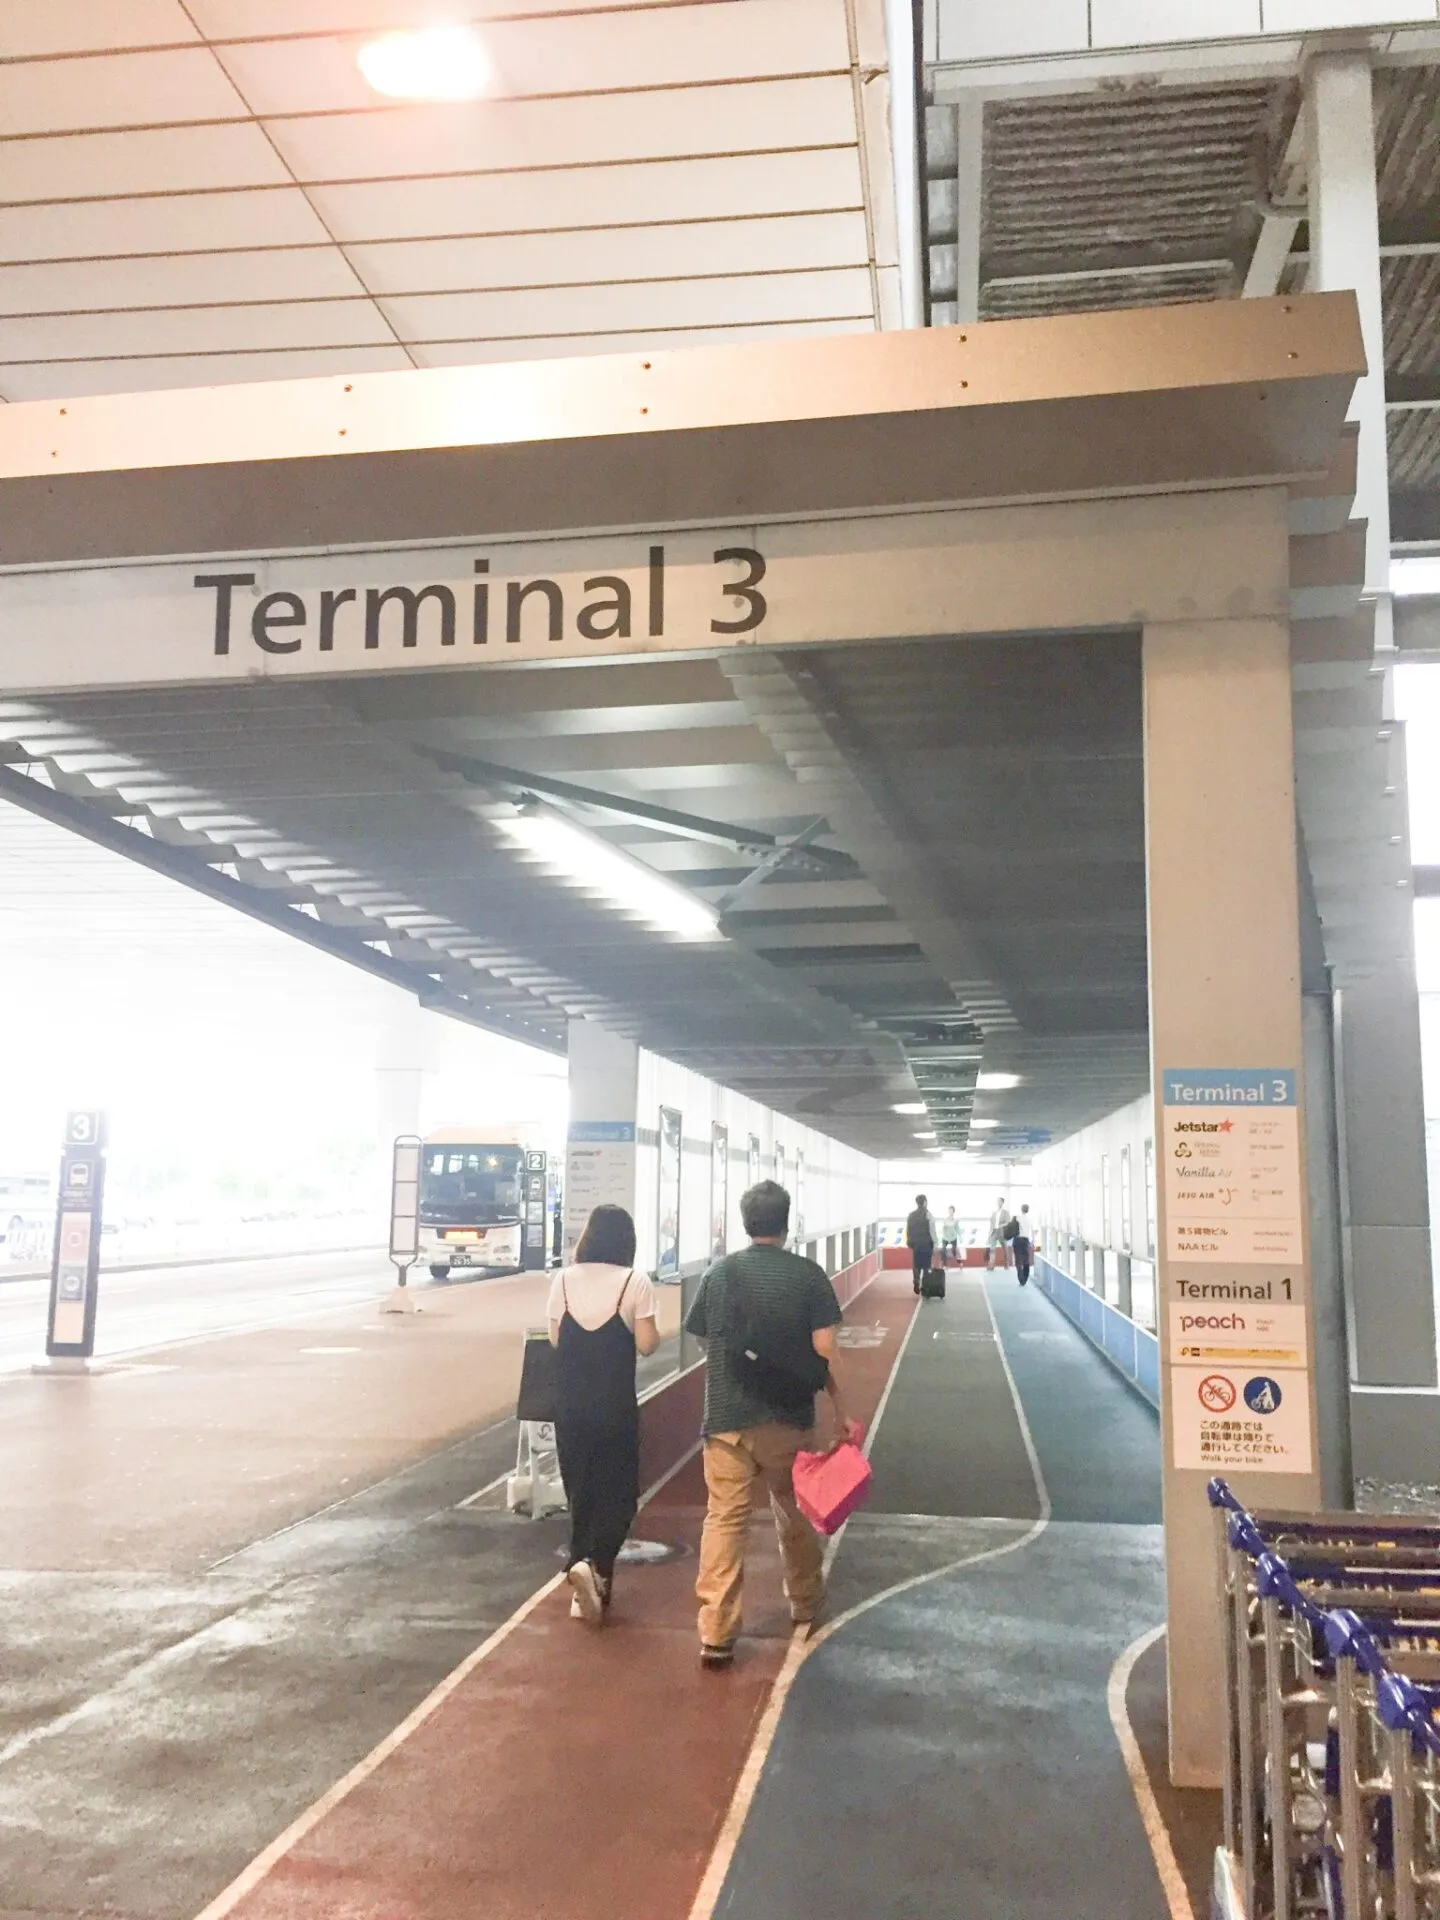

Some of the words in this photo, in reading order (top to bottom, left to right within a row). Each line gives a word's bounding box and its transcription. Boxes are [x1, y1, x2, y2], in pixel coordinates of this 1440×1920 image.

[194, 546, 664, 655] Terminal
[710, 547, 767, 634] 3
[1170, 1083, 1264, 1101] Terminal
[1272, 1079, 1287, 1102] 3
[71, 1114, 90, 1140] 3
[1174, 1122, 1219, 1133] Jetstar
[530, 1154, 542, 1169] 2
[1176, 1166, 1216, 1178] Vanilla
[1176, 1279, 1272, 1300] Terminal
[1281, 1278, 1292, 1300] 1
[1179, 1313, 1246, 1332] peach
[1200, 1420, 1263, 1431] この通路では
[1200, 1431, 1275, 1442] 自転車は降りて
[1224, 1456, 1243, 1464] your
